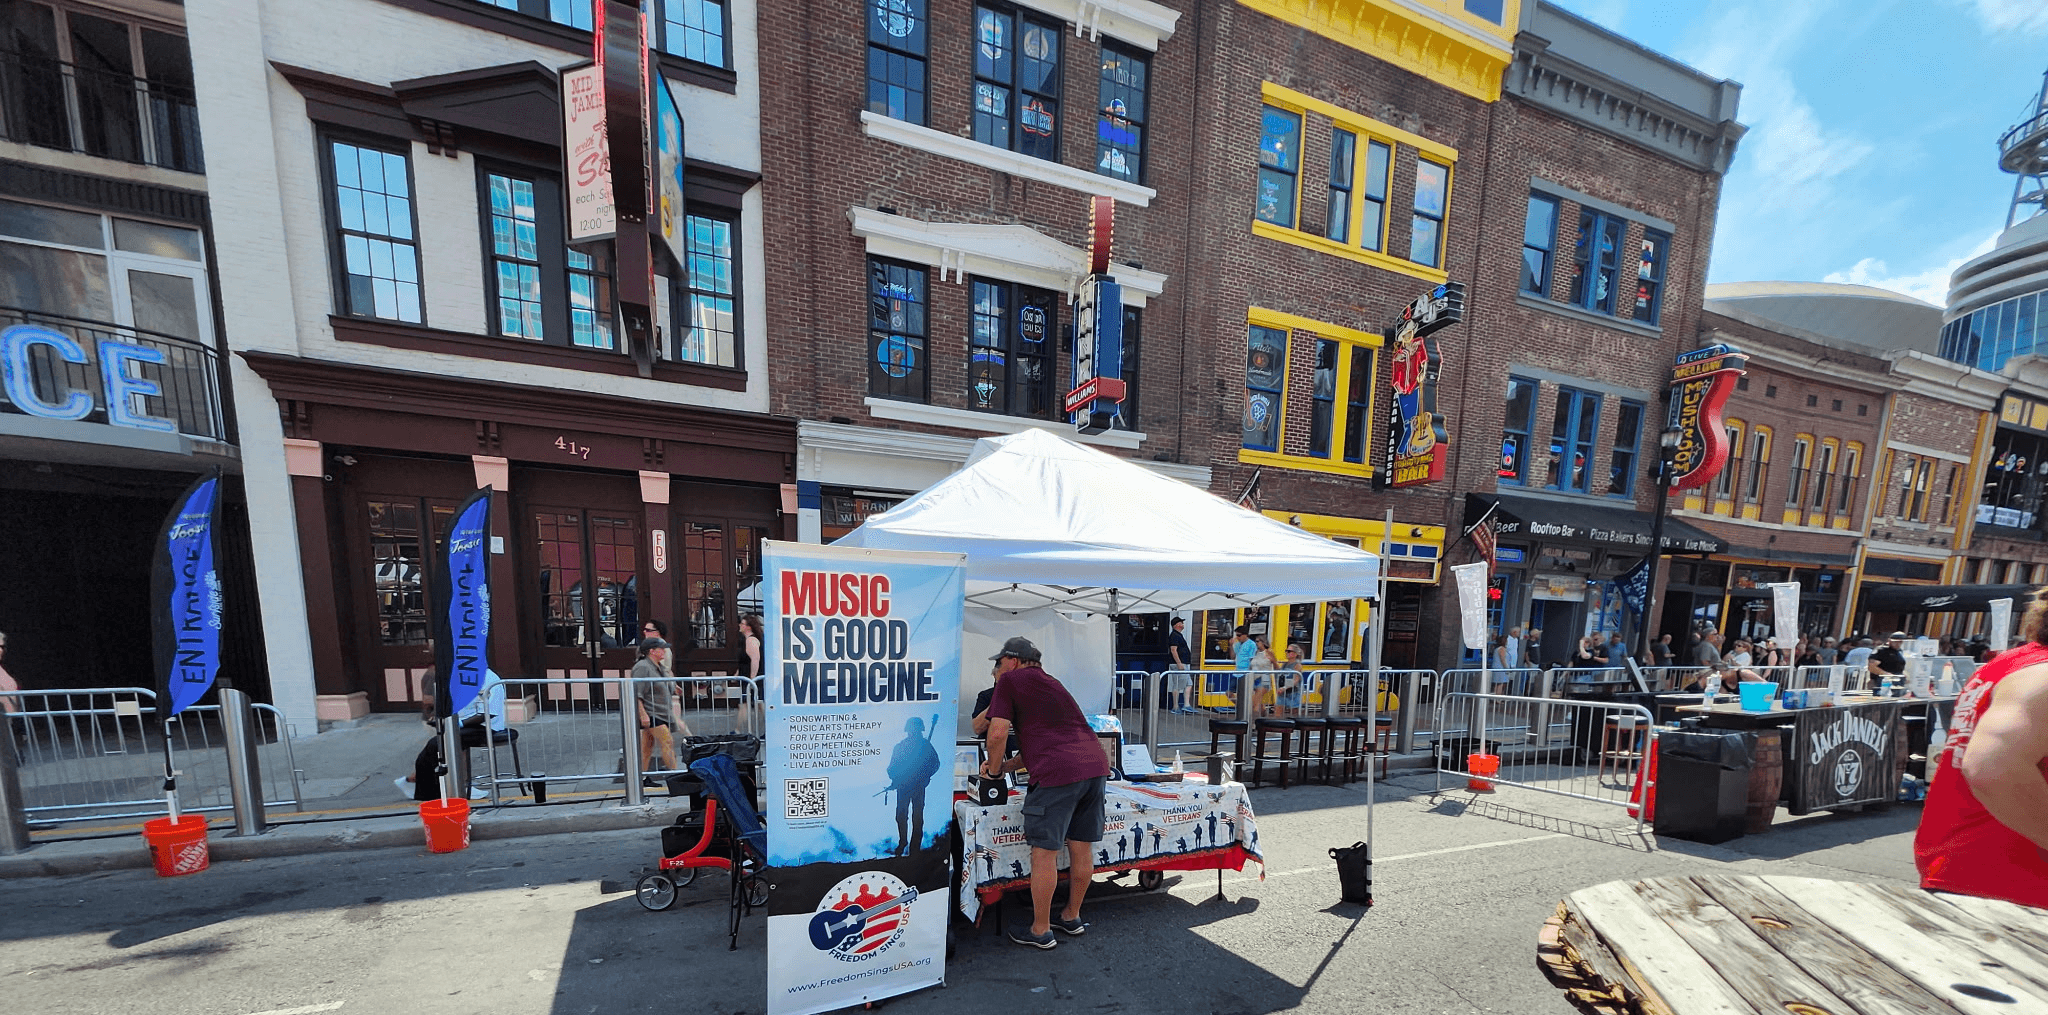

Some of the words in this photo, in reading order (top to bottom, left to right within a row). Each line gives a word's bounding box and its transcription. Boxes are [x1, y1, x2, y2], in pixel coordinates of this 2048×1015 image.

[575, 190, 596, 205] each
[579, 218, 602, 232] 12:00
[1688, 351, 1710, 362] LIVE
[1674, 358, 1723, 379] MELLOW
[1066, 383, 1097, 407] WILLIAMS
[1673, 380, 1704, 473] MUSHROOM
[554, 436, 591, 460] 417
[1384, 429, 1396, 485] JACKSON
[1395, 463, 1430, 484] BAR
[1496, 522, 1520, 533] Beer
[1530, 521, 1561, 535] Rooftop
[1561, 525, 1575, 537] Bar
[1590, 528, 1609, 541] Pizza
[1609, 530, 1634, 544] Bakers
[1685, 540, 1698, 551] Live
[1698, 540, 1718, 552] Music
[655, 533, 664, 569] FDC
[781, 570, 890, 618] MUSIC
[781, 617, 814, 661] IS
[824, 618, 908, 661] GOOD
[783, 661, 939, 705] MEDICINE.
[789, 714, 850, 723] SONGWRITING
[851, 713, 858, 721] &
[789, 724, 817, 732] MUSIC
[819, 723, 842, 732] ARTS
[843, 721, 882, 730] THERAPY
[789, 733, 807, 742] FOR
[809, 732, 854, 741] VETERANS
[789, 742, 820, 751] GROUP
[821, 741, 864, 750] MEETINGS
[1811, 719, 1842, 765] JACK
[789, 751, 839, 760] INDIVIDUAL
[841, 748, 881, 757] SESSIONS
[790, 761, 810, 769] LIVE
[812, 760, 830, 768] AND
[832, 758, 862, 767] ONLINE
[1162, 812, 1202, 824] VETERANS
[1163, 807, 1188, 816] THANK
[1188, 804, 1203, 813] YOU
[992, 825, 1021, 836] THANK
[828, 948, 878, 963] FREEDOM
[879, 927, 904, 953] SINGS
[900, 905, 911, 926] USA
[787, 957, 931, 994] www.FreedomSingsUSA.org
